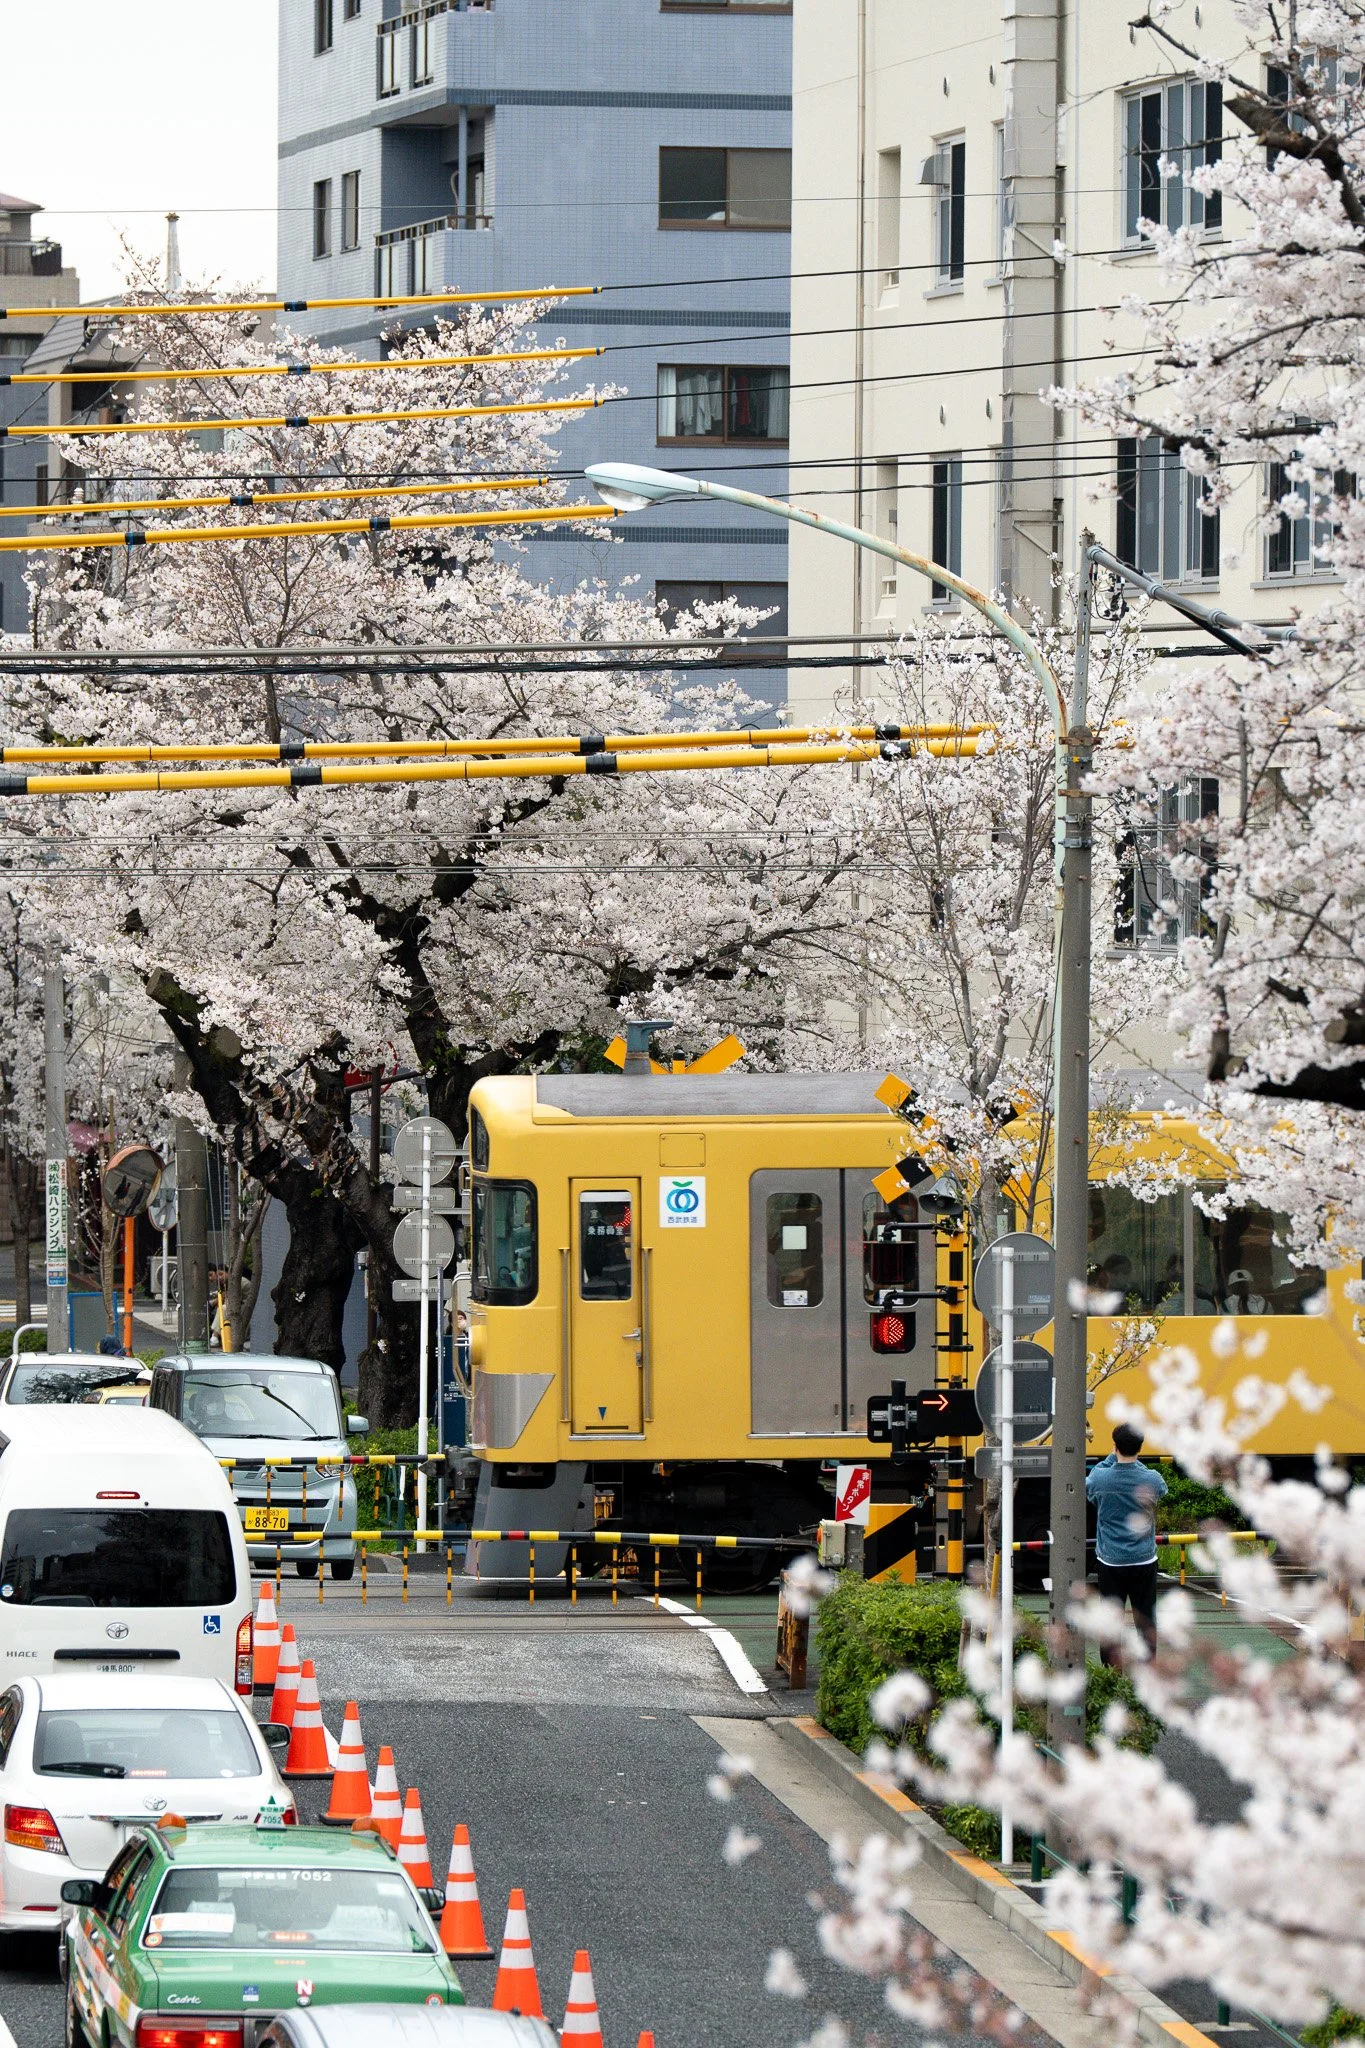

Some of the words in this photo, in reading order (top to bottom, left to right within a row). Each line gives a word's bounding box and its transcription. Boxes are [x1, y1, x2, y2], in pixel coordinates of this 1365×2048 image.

[667, 1216, 698, 1224] 西武鉄道
[587, 1225, 625, 1236] 乗務員室
[842, 1471, 870, 1512] 非常ボタン
[255, 1516, 286, 1529] 88-70
[6, 1650, 38, 1658] HIACE
[118, 1664, 133, 1673] 800
[263, 1815, 282, 1824] 7052
[291, 1871, 332, 1882] 7052
[167, 1993, 202, 2005] Cedric
